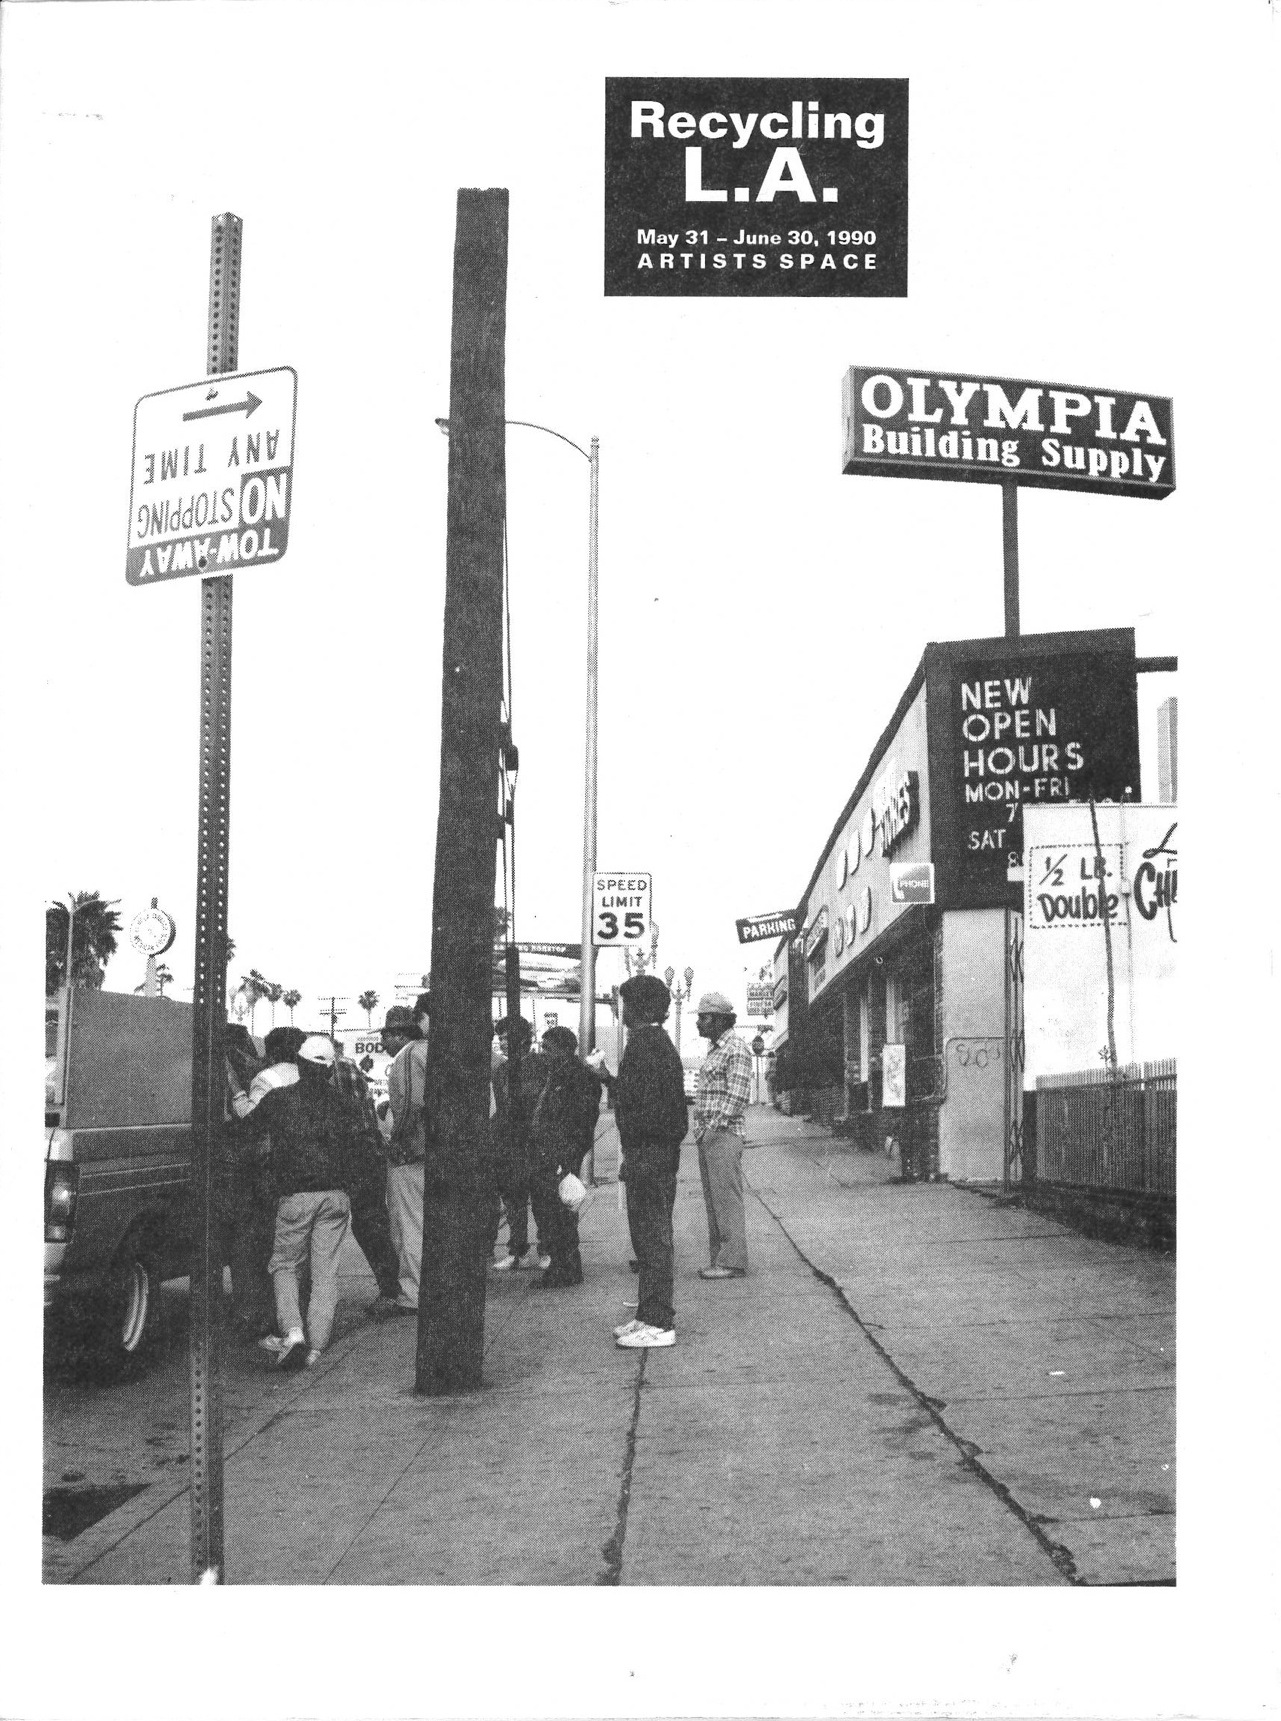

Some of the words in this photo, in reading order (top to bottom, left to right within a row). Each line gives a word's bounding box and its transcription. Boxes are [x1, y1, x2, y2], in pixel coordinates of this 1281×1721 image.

[861, 374, 1167, 446] OLYMPIA
[143, 443, 207, 485] TIME
[228, 429, 280, 467] ANY
[861, 423, 1020, 467] Building
[1041, 438, 1167, 482] Supply
[137, 487, 235, 539] STOPPING
[241, 472, 289, 525] NO
[140, 527, 280, 577] TOW-AWAY
[961, 677, 1032, 712] NEW
[962, 707, 1057, 742] OPEN
[963, 741, 1084, 778] HOURS
[965, 777, 1070, 803] MON-FRI
[967, 829, 1006, 850] SAT
[596, 879, 648, 891] SPEED
[900, 879, 930, 889] PHONE
[601, 896, 643, 908] LIMIT
[1037, 886, 1119, 922] Double
[597, 911, 646, 940] 35
[743, 918, 796, 939] PARKING
